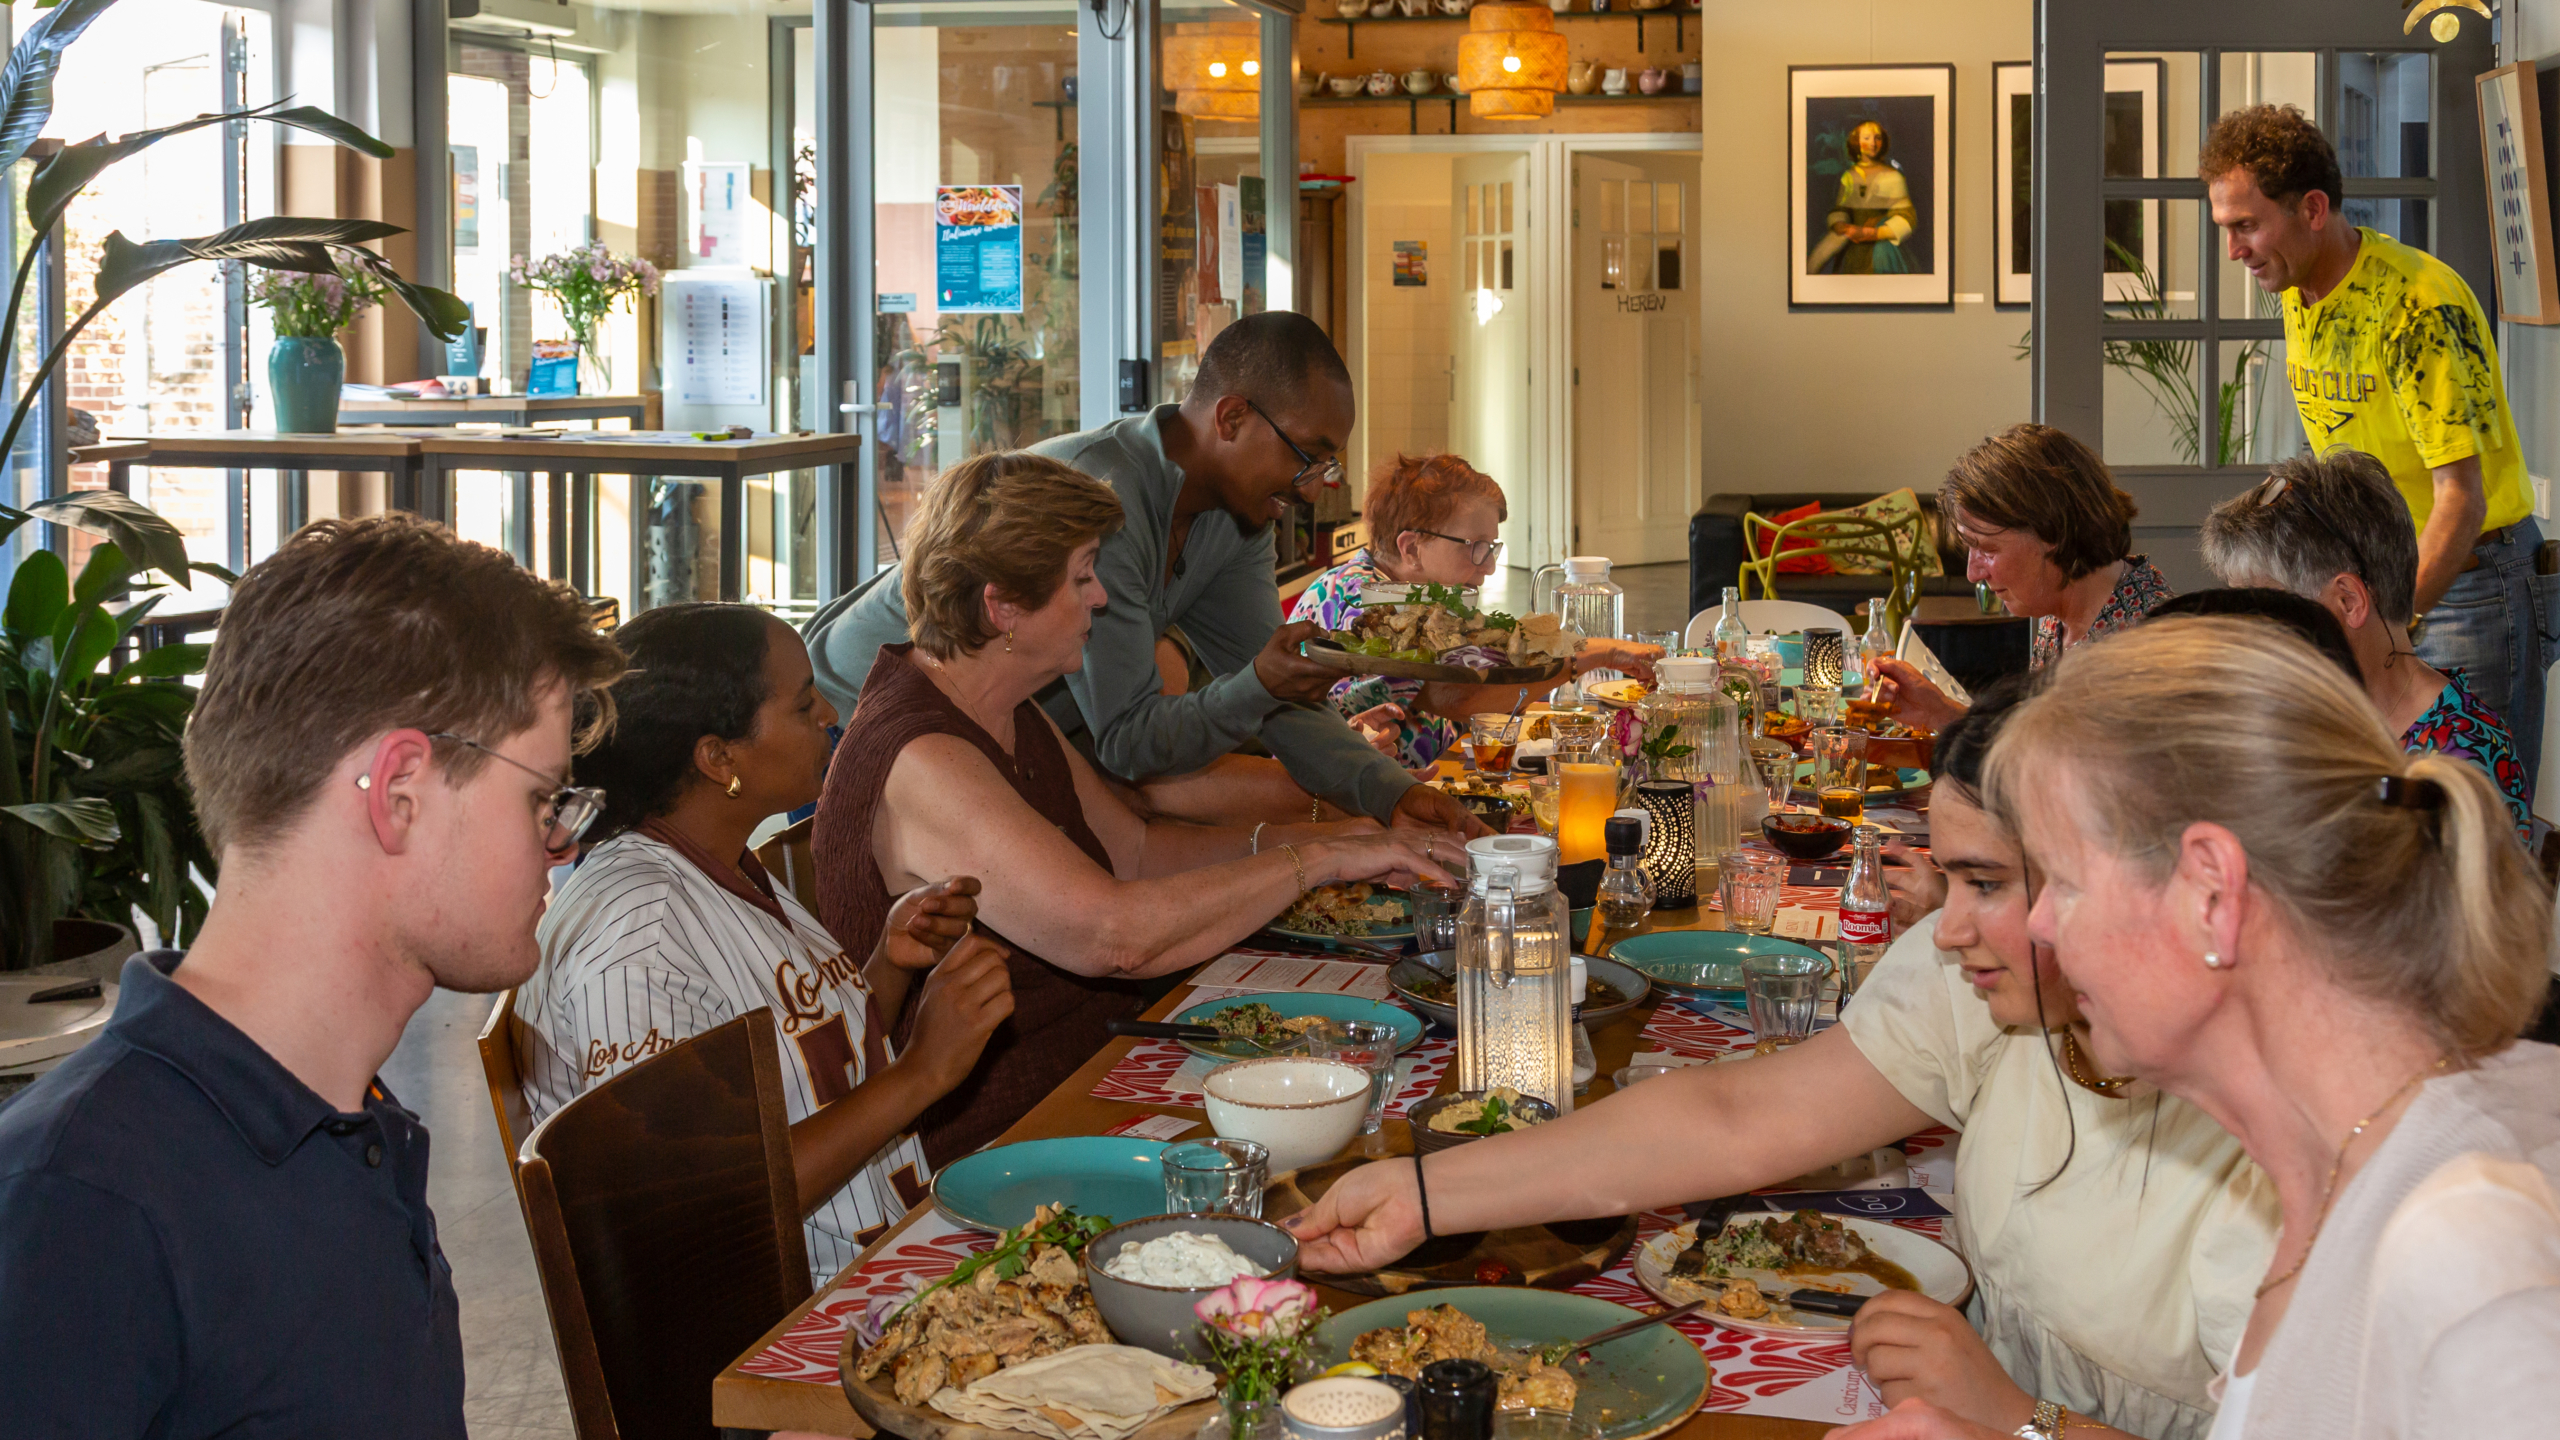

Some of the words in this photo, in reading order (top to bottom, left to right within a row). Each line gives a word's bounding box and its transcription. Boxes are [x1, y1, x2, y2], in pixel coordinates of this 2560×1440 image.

[1617, 293, 1667, 313] HEREN
[1842, 918, 1881, 933] Roomie
[583, 1038, 619, 1081] Los
[622, 1027, 690, 1062] An
[1835, 1370, 1861, 1416] Castricum
